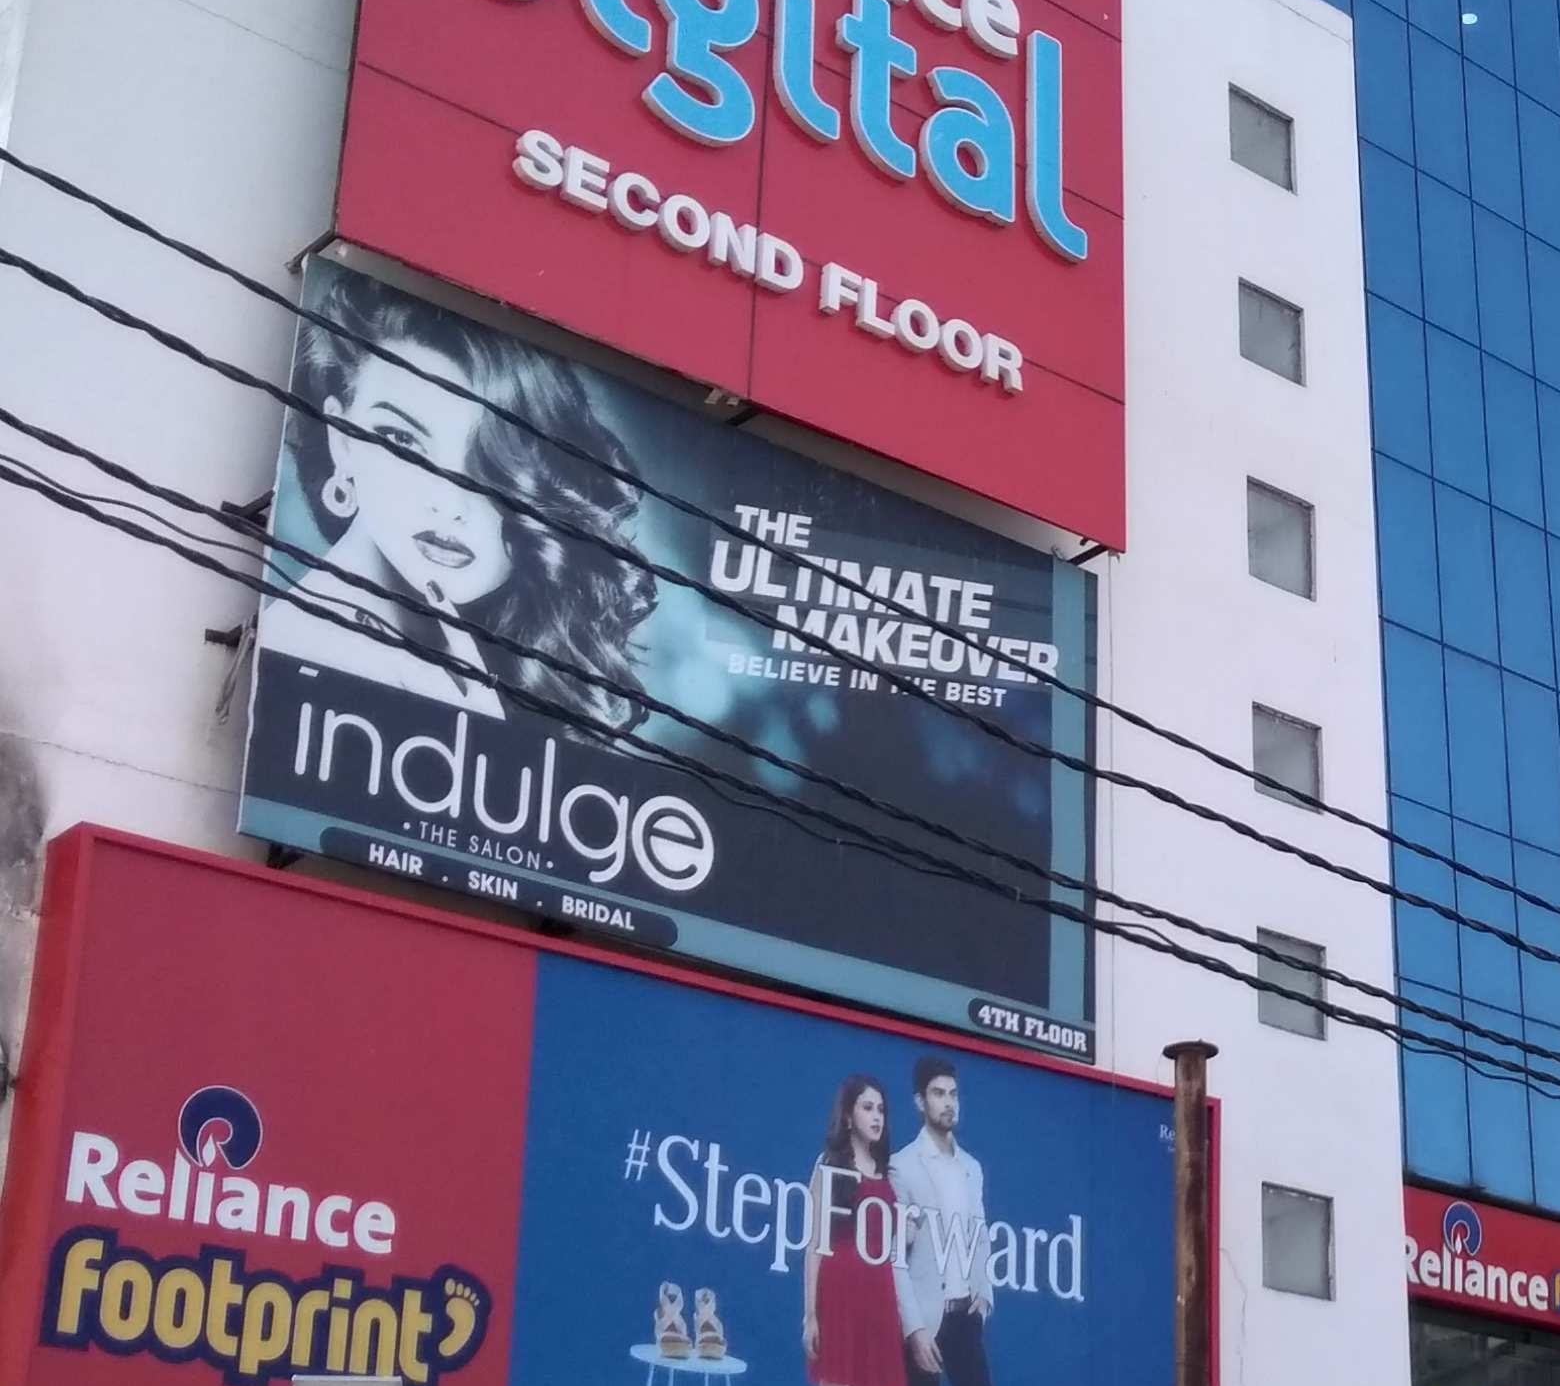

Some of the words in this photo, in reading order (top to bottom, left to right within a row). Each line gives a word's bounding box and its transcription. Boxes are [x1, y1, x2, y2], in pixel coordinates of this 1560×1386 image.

[512, 128, 805, 294] SECOND
[819, 261, 1025, 395] FLOOR
[734, 503, 813, 549] THE
[709, 540, 995, 629] ULTIMATE
[727, 652, 842, 688] BELIEVE
[849, 668, 879, 692] IN
[945, 680, 1007, 708] BEST
[772, 604, 1061, 686] MAKEOVER
[294, 667, 715, 892] indulge
[368, 843, 424, 877] HAIR
[467, 870, 519, 901] SKIN
[561, 894, 636, 932] BRIDAL
[418, 820, 458, 848] THE
[467, 835, 543, 871] SALON
[978, 1004, 1020, 1033] 4TH
[1023, 1015, 1088, 1053] FLOOR
[64, 1130, 397, 1256] Reliance
[624, 1128, 1086, 1303] #StepForward
[56, 1237, 433, 1384] footprint
[1403, 1231, 1549, 1312] Reliance
